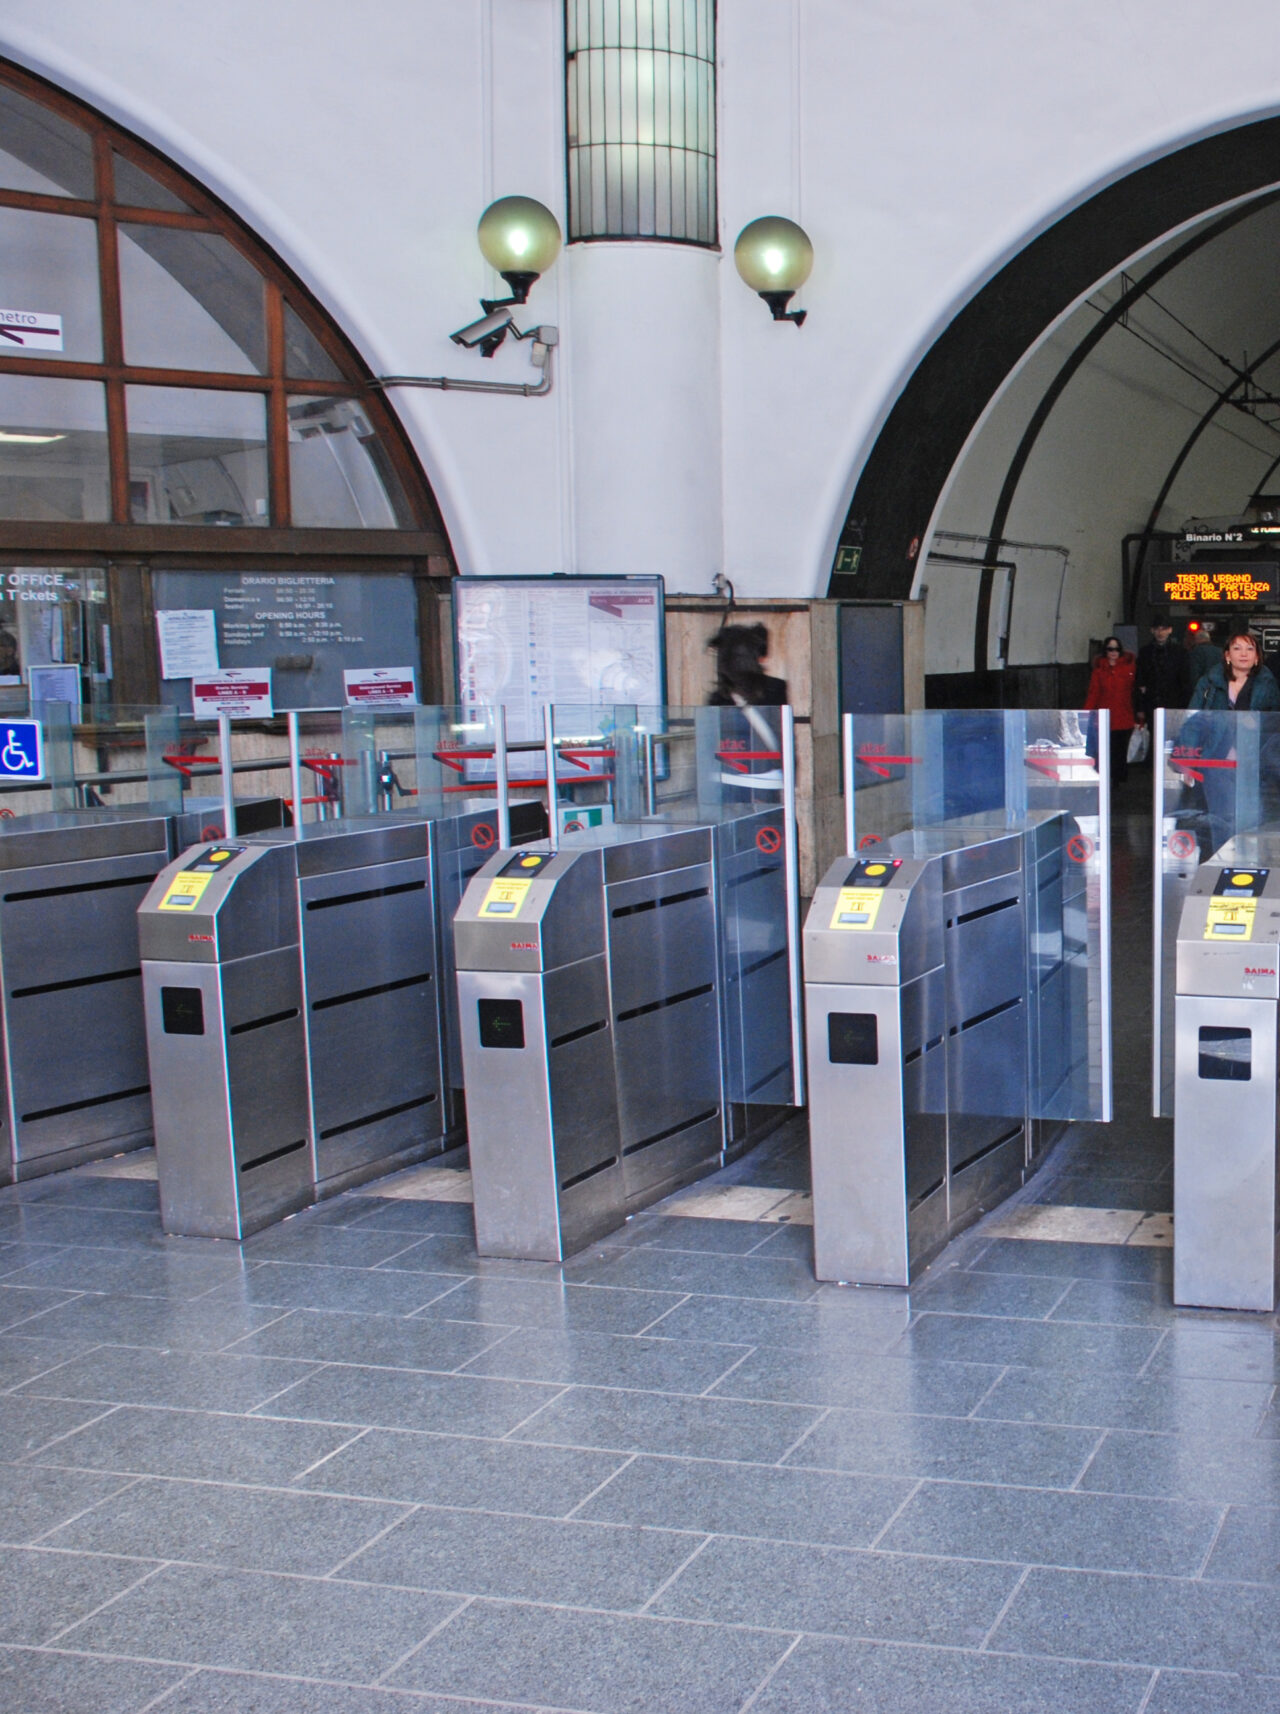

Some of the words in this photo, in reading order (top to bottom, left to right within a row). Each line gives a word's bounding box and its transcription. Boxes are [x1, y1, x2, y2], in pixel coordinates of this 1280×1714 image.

[1185, 533, 1222, 542] Binario
[8, 574, 63, 586] OFFICE
[242, 577, 276, 585] ORARIO
[278, 577, 335, 585] BIGLIETTERIA
[1176, 574, 1208, 583] TRENO
[1213, 574, 1251, 583] URBANO
[1164, 582, 1214, 592] PROSSIMA
[1219, 582, 1270, 592] PARTENZA
[6, 589, 58, 601] Tckets
[1170, 591, 1195, 600] ALLE
[1201, 591, 1220, 600] ORE
[1226, 591, 1257, 600] 10.52
[255, 612, 294, 620] OPENING
[1173, 746, 1202, 758] atac
